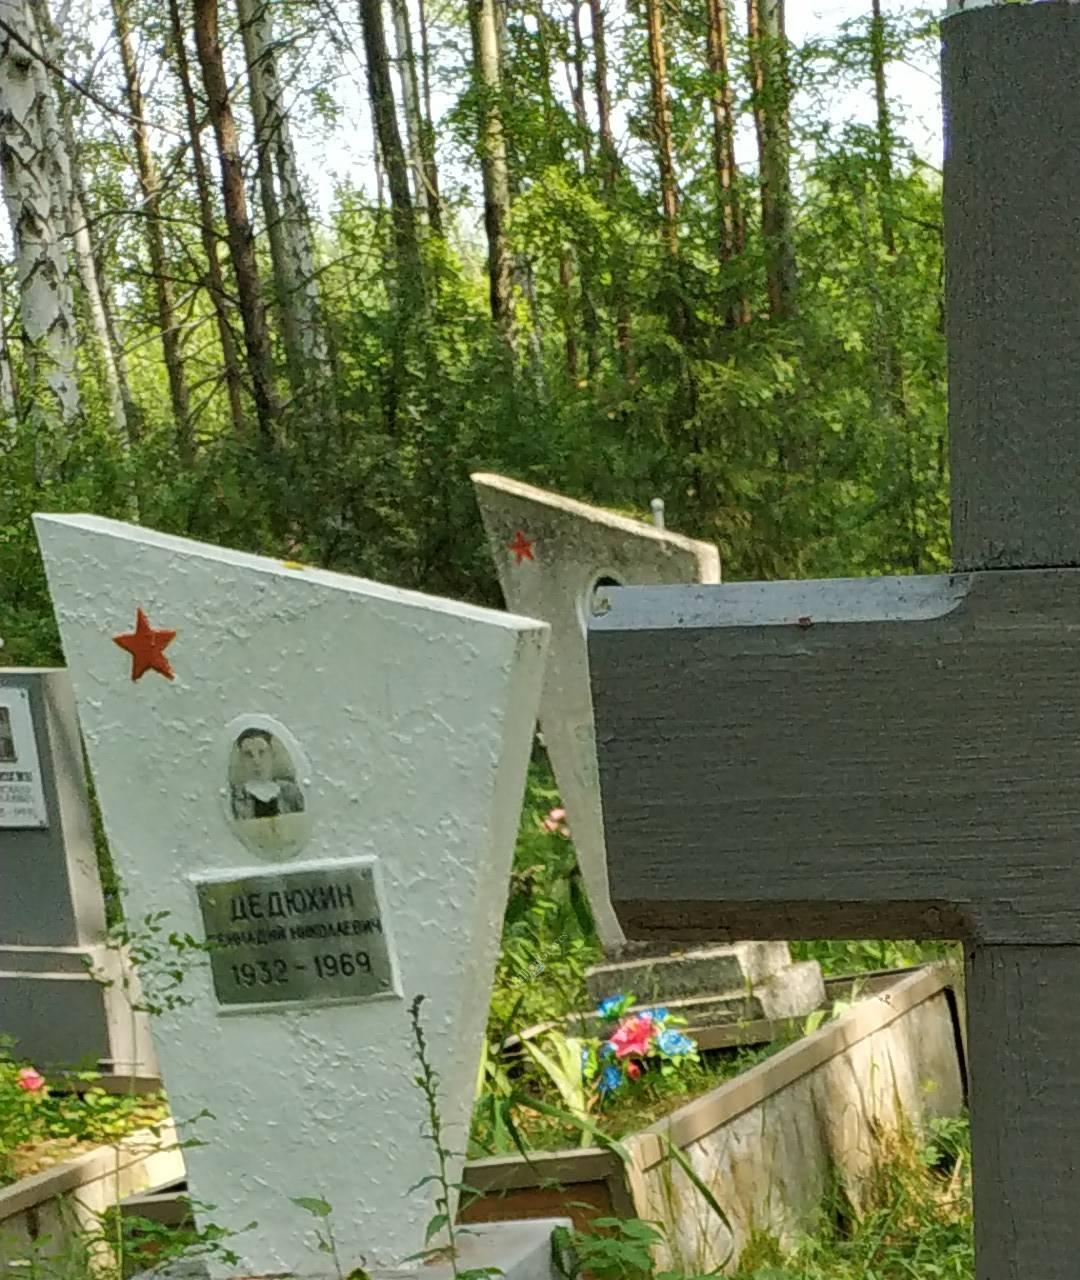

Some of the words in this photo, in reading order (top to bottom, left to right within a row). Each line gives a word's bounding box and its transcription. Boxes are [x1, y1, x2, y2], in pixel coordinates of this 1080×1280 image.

[231, 884, 354, 923] ДЕДЮХИН
[232, 958, 289, 987] 1932
[314, 951, 372, 979] 1969
